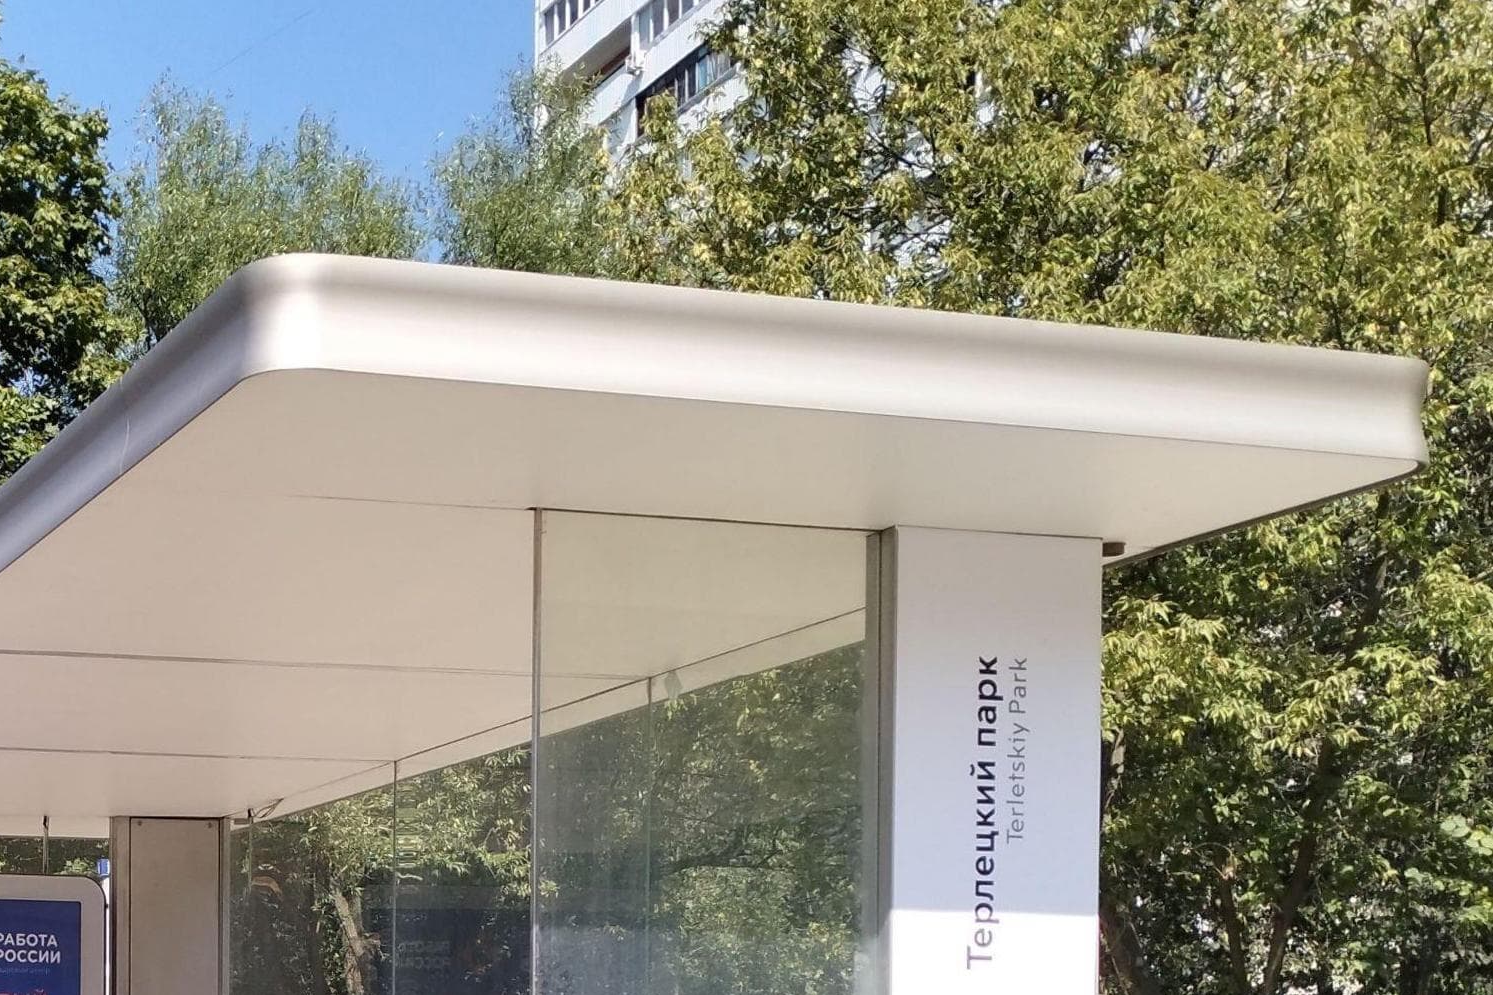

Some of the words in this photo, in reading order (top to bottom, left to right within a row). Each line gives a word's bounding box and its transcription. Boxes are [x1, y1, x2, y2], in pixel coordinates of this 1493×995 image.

[977, 656, 1004, 748] парк
[1008, 657, 1028, 714] Park
[1006, 722, 1030, 845] Terletskiy
[966, 761, 1000, 970] Терлецкий
